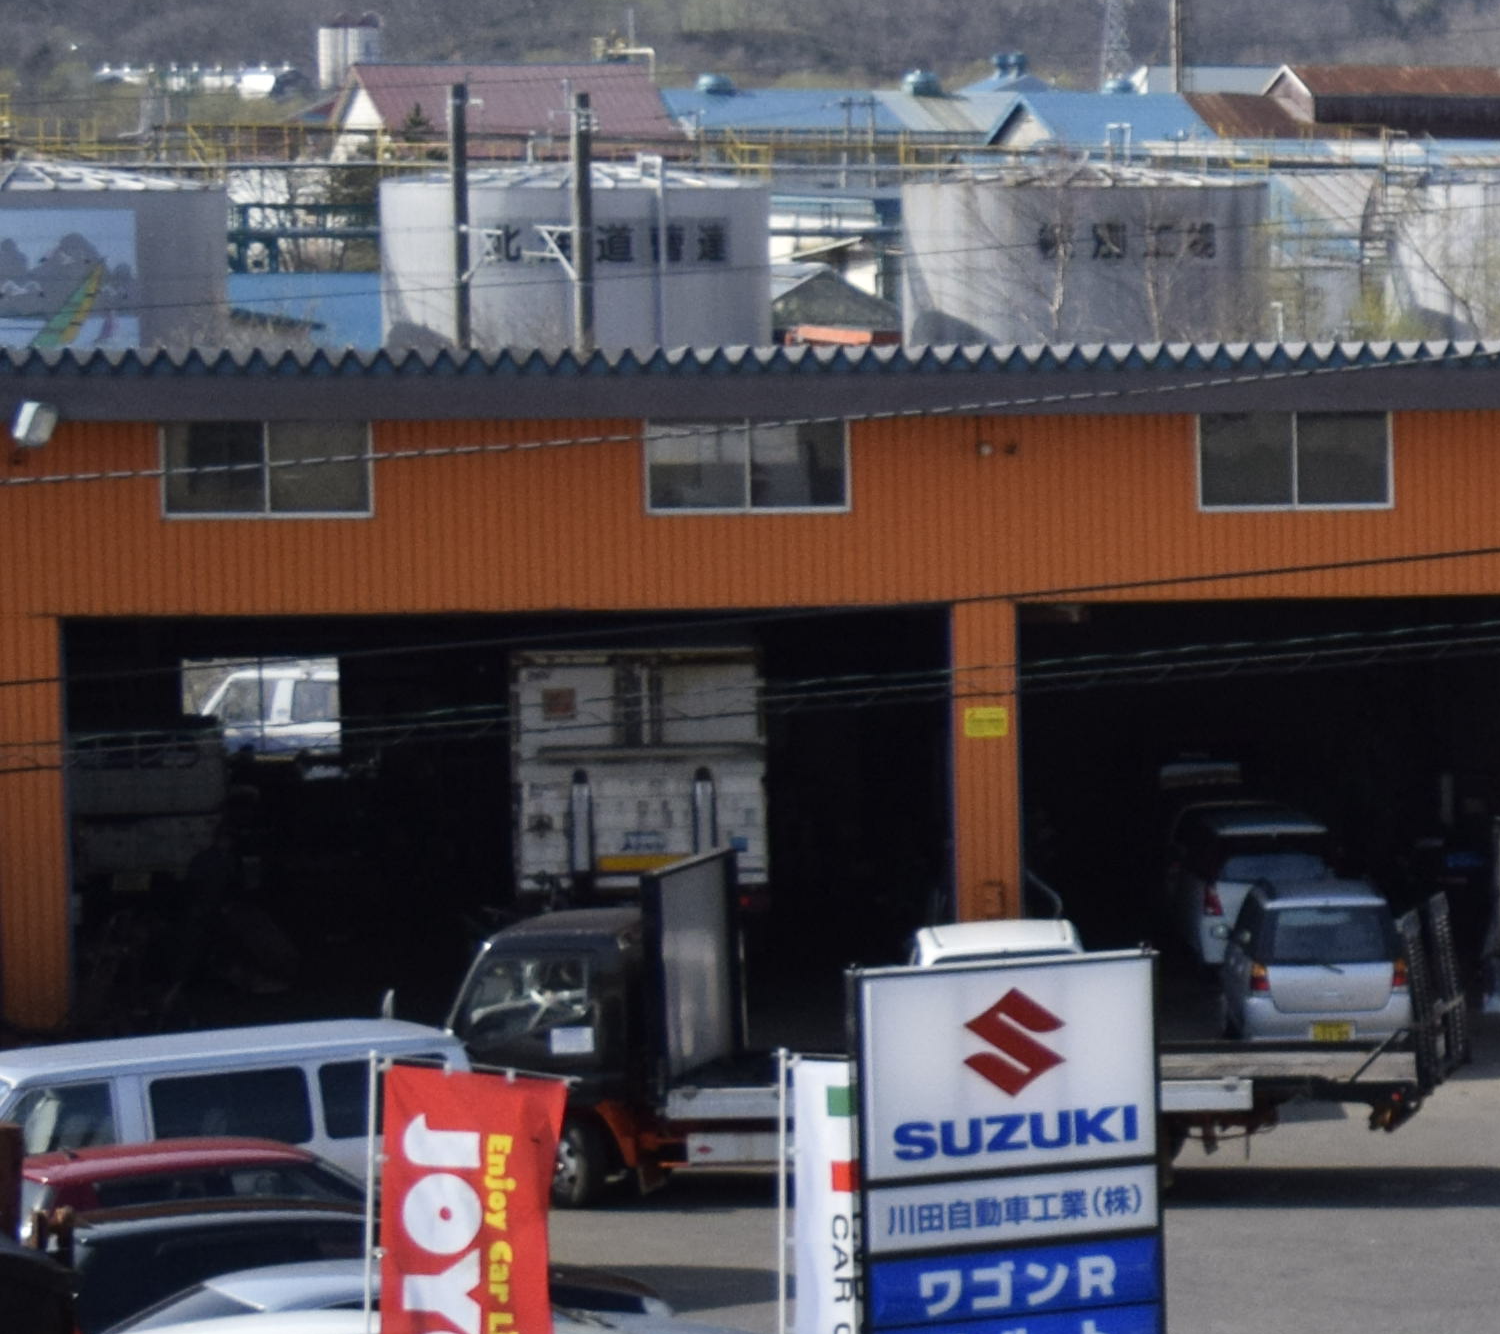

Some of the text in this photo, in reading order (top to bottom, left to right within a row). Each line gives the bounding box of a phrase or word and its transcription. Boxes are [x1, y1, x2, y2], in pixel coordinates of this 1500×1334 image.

[893, 1104, 1138, 1161] SUZUKI
[484, 1133, 518, 1232] Enjoy
[887, 1183, 1143, 1236] 川田自動車工業(株)
[488, 1240, 513, 1303] Car
[831, 1213, 855, 1304] CAR
[919, 1254, 1118, 1317] ワゴンR
